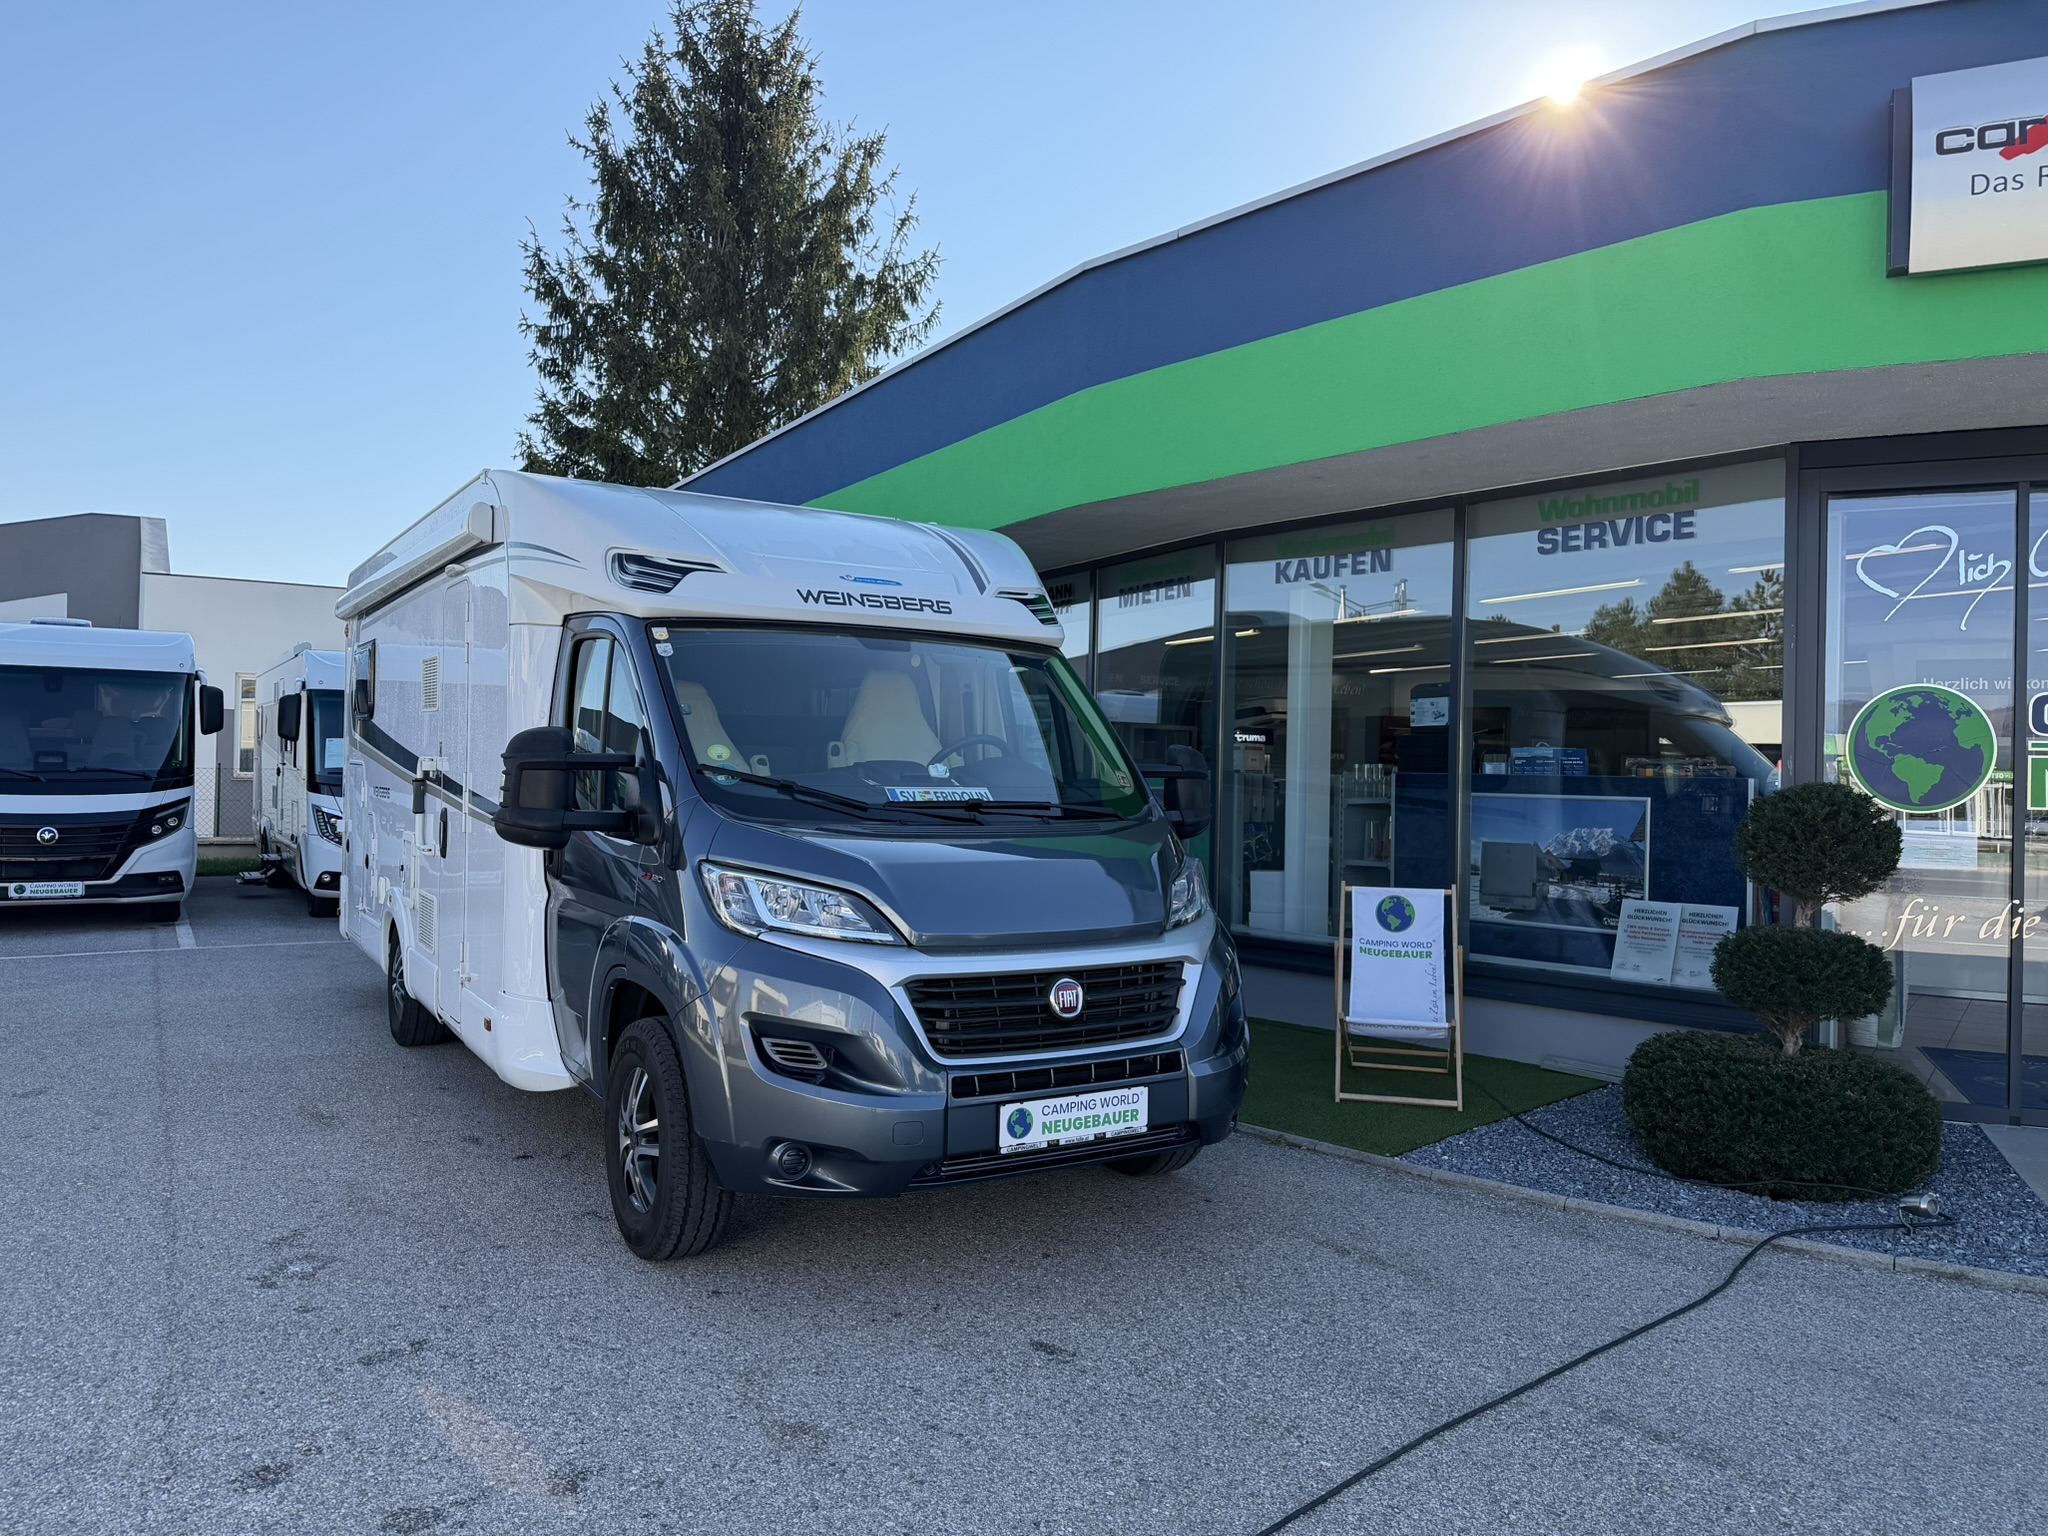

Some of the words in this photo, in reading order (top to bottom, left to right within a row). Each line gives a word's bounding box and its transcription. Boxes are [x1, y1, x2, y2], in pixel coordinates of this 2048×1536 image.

[1970, 173, 2024, 196] Das
[1537, 479, 1699, 522] Wohnmobil
[1536, 510, 1696, 556] SERVICE
[1275, 548, 1393, 585] KAUFEN
[796, 588, 953, 615] WEINSBERG
[1118, 575, 1193, 609] MIETEN
[1233, 731, 1266, 743] truma
[1627, 913, 1673, 923] GLÜCKWUNSCH!
[1633, 907, 1668, 916] HERZLICHEN
[1688, 911, 1724, 920] HERZLICHEN
[1979, 899, 2041, 940] die
[1358, 937, 1399, 949] CAMPING
[1401, 941, 1433, 950] WORLD
[1358, 946, 1433, 960] NEUGEBAUER
[1058, 989, 1078, 1009] FIAT
[1041, 1098, 1097, 1117] CAMPING
[1099, 1093, 1140, 1109] WORLD
[1041, 1108, 1140, 1136] NEUGEBAUER
[1006, 1142, 1042, 1153] CAMPINGWELT
